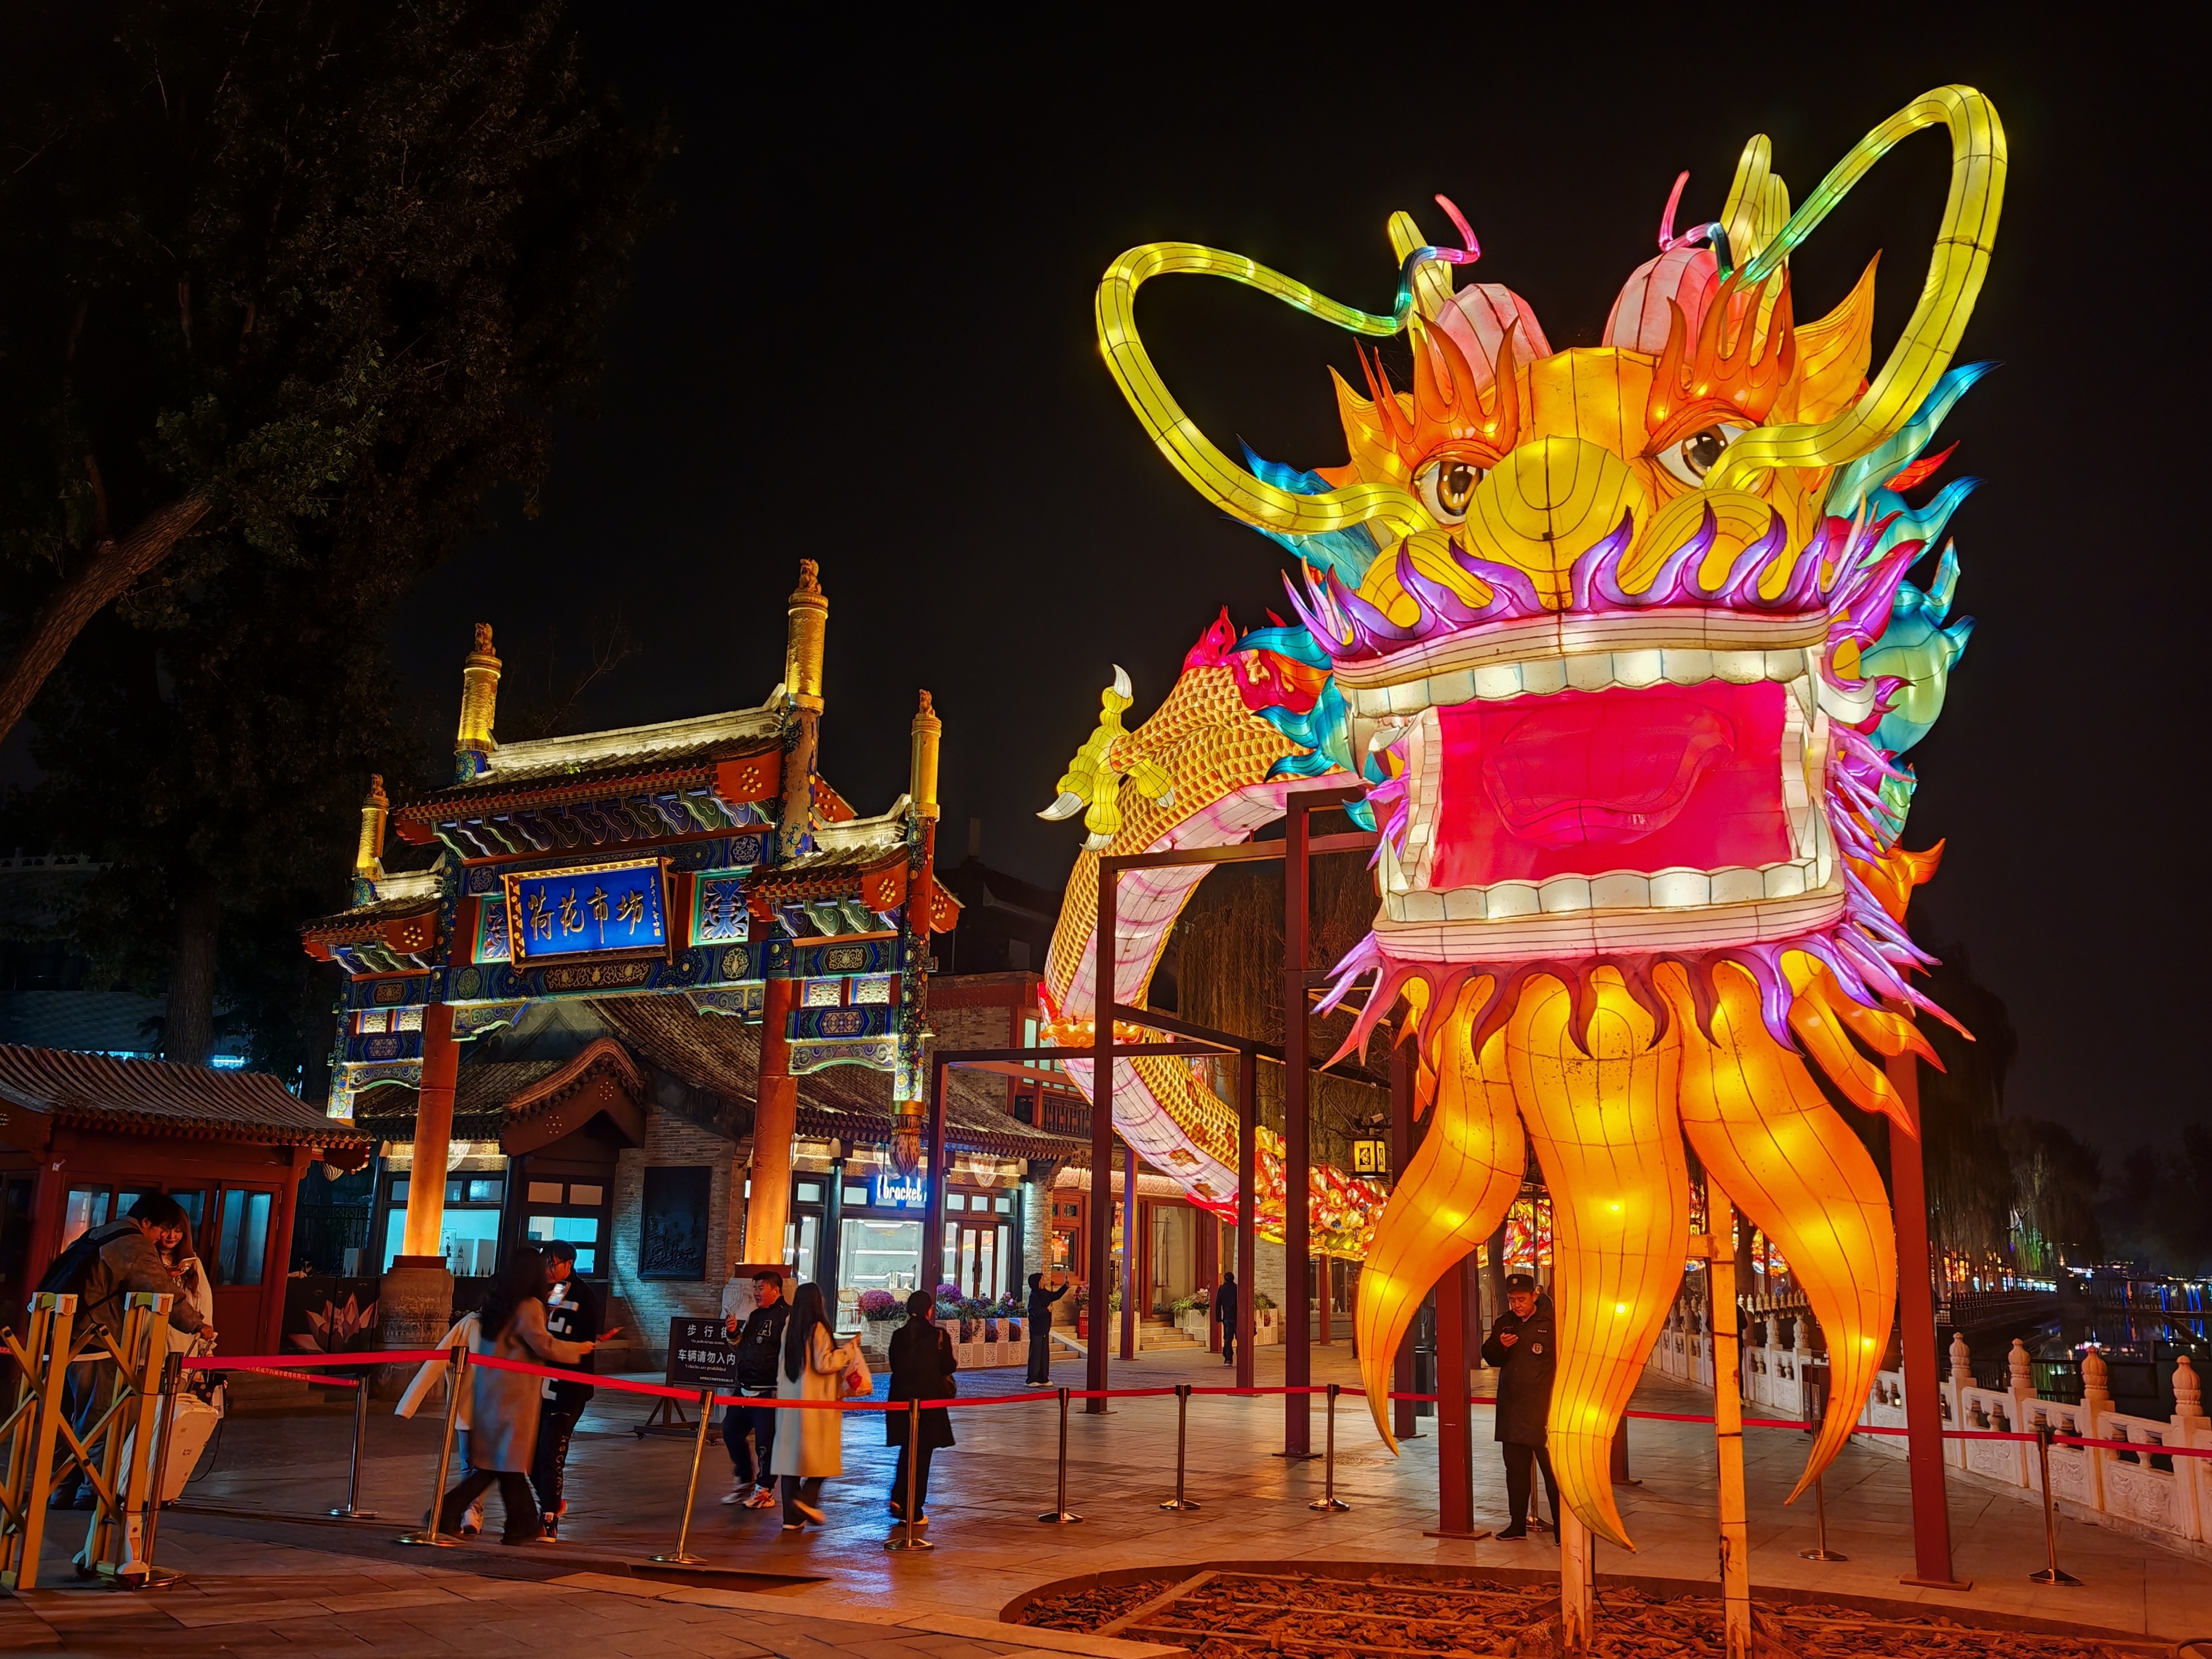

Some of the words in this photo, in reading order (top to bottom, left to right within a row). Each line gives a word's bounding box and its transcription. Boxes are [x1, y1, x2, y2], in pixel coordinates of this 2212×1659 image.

[678, 1348, 736, 1366] 车辆请勿入内
